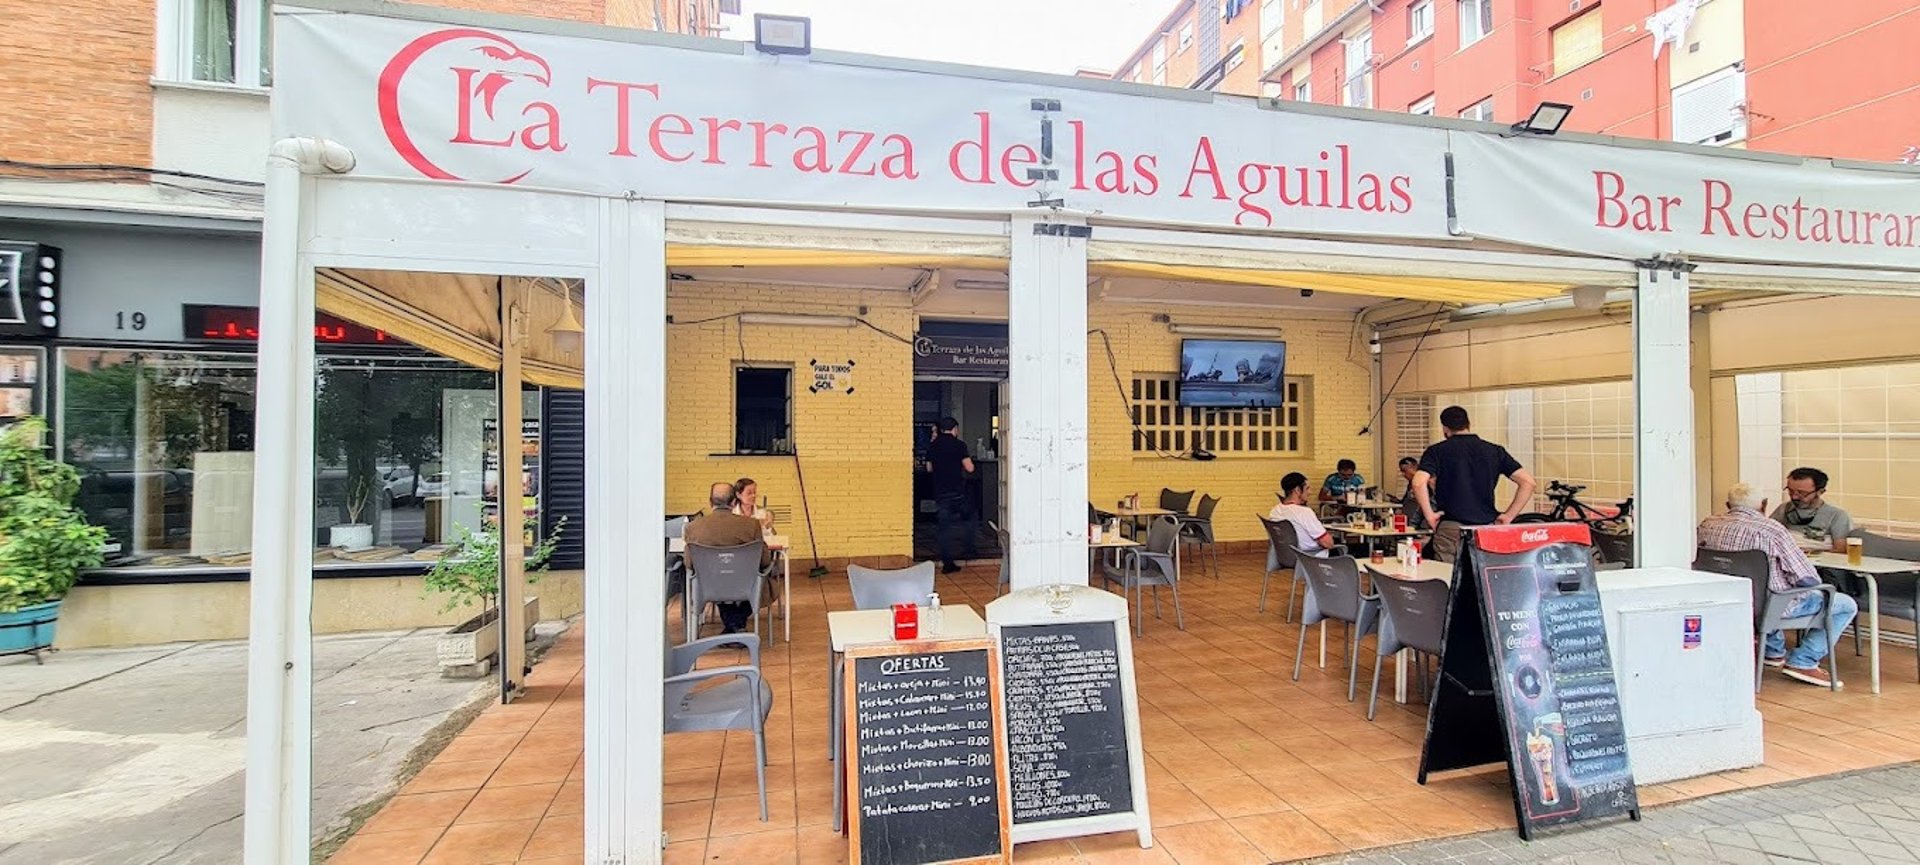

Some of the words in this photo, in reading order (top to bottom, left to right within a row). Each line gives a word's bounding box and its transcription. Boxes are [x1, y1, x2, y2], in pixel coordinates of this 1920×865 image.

[449, 67, 567, 152] La
[587, 77, 919, 180] Terraza
[948, 111, 1038, 188] de
[1068, 120, 1159, 196] las
[1179, 136, 1412, 228] Aguilas
[1592, 170, 1682, 233] Bar
[115, 311, 147, 330] 19
[933, 345, 961, 354] Terraza
[963, 345, 974, 354] de
[953, 356, 967, 364] Bar
[815, 381, 833, 390] SOL
[1498, 611, 1511, 620] TU
[1511, 623, 1530, 631] CON
[880, 655, 944, 673] OFERTAS
